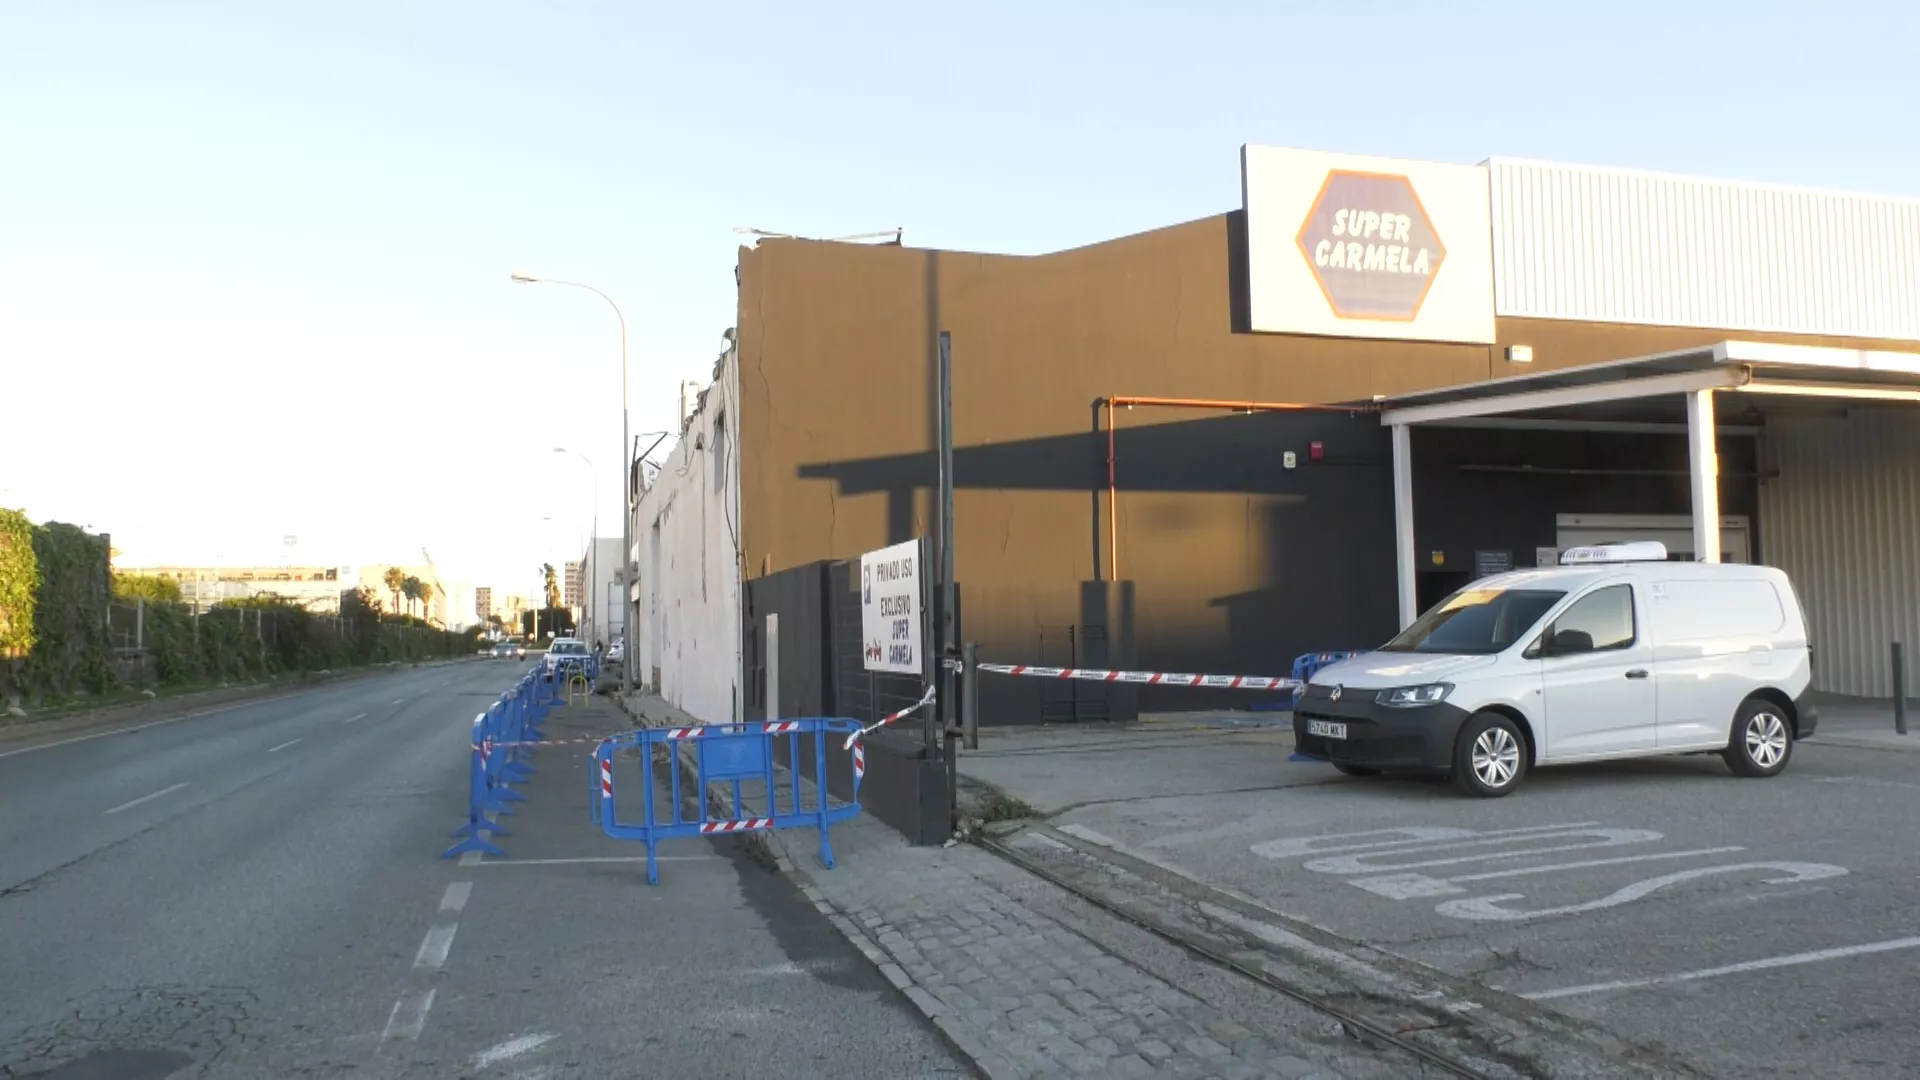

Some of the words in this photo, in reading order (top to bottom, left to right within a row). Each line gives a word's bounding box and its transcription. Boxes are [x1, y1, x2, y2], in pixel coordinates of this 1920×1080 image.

[1332, 208, 1412, 244] SUPER
[1315, 239, 1430, 275] CARMELA
[877, 560, 900, 582] PRIVADO
[901, 557, 913, 578] USO
[881, 594, 911, 617] EXCLUSIVO
[892, 618, 910, 640] SUPER
[889, 644, 913, 665] CARMELA
